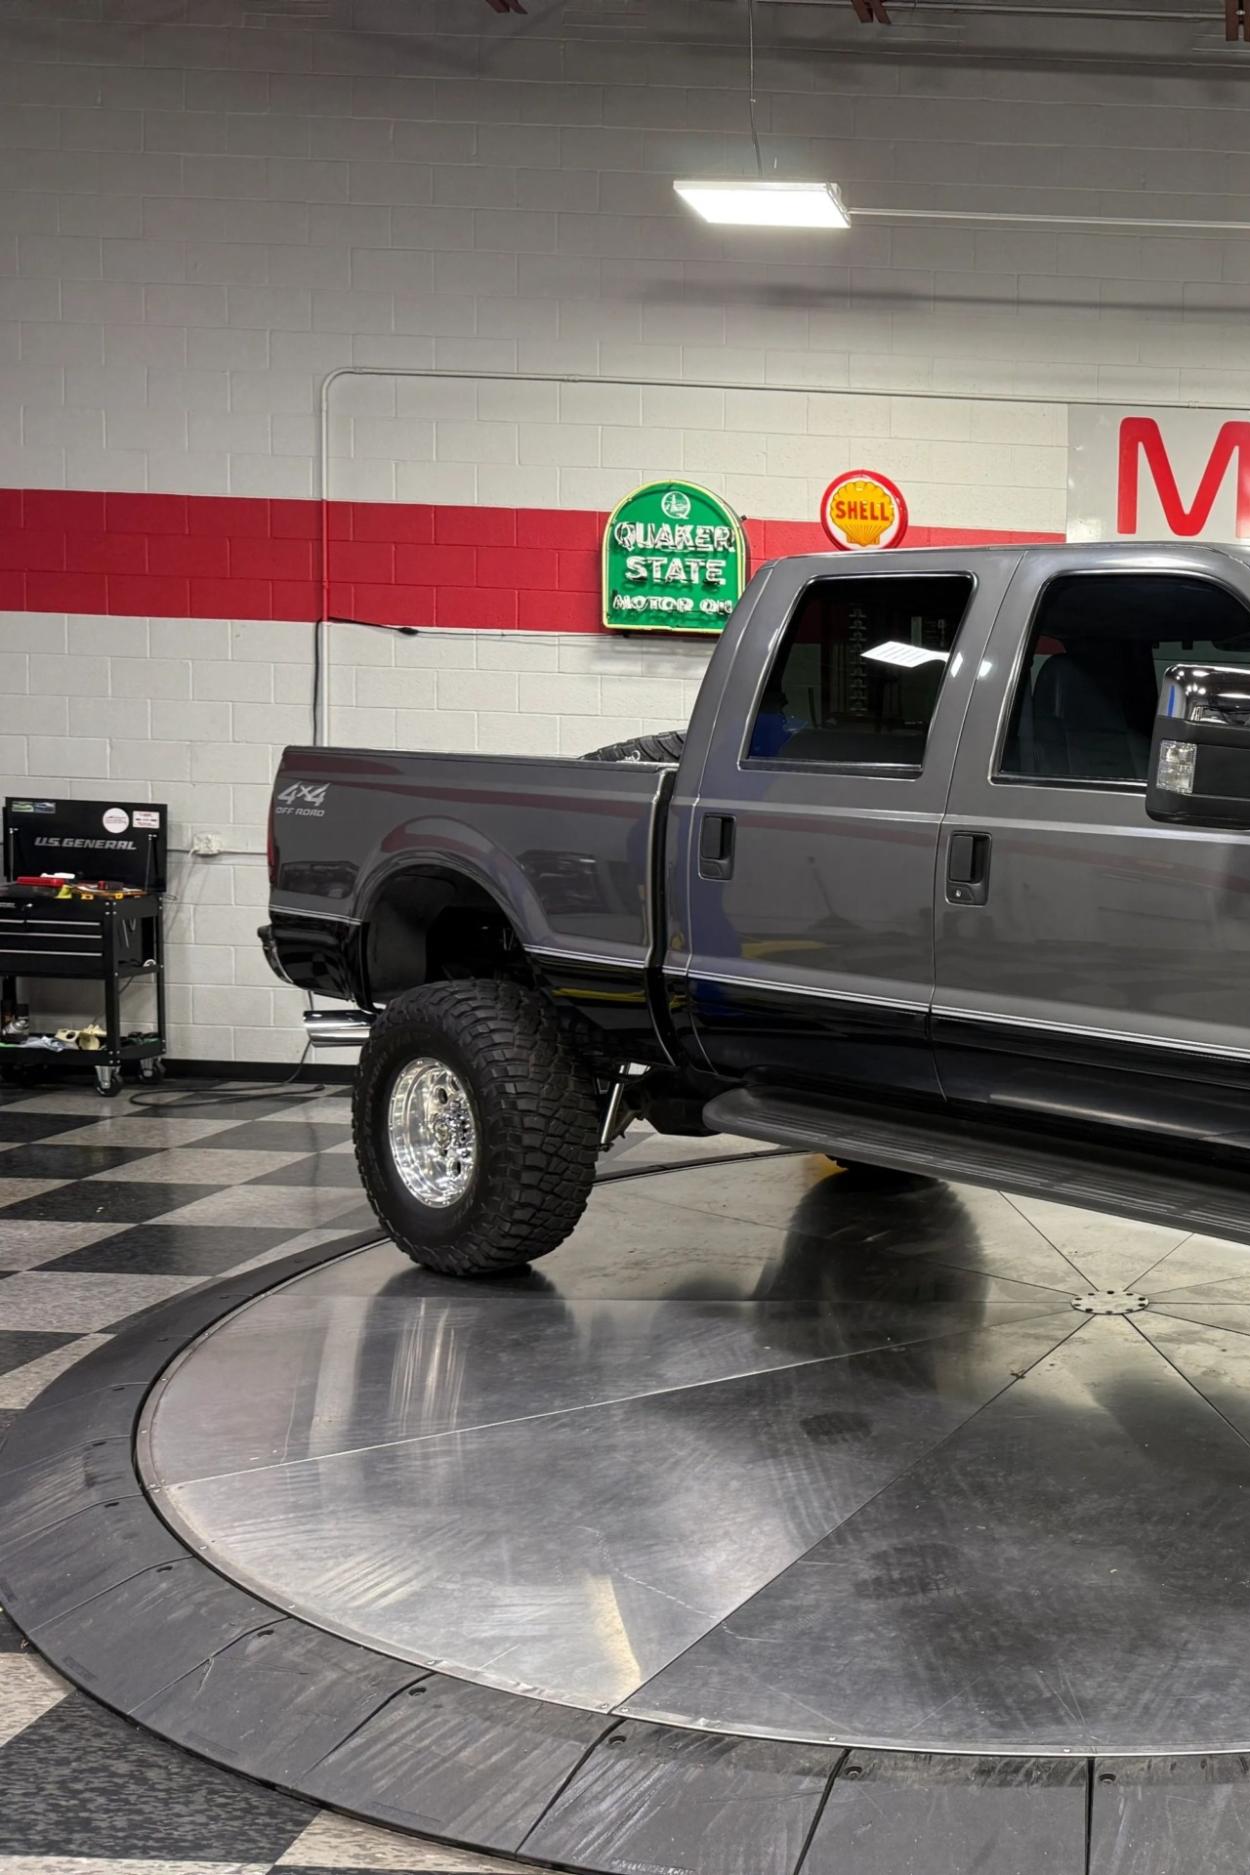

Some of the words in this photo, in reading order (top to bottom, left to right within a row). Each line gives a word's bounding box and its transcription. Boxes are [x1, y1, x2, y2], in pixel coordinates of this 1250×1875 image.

[834, 499, 890, 521] SHELL
[613, 522, 736, 552] QUAKER
[625, 556, 727, 585] STATE
[613, 594, 694, 612] MOTOR
[700, 598, 733, 614] OIL
[275, 806, 295, 815] OFF
[295, 807, 325, 817] ROAD
